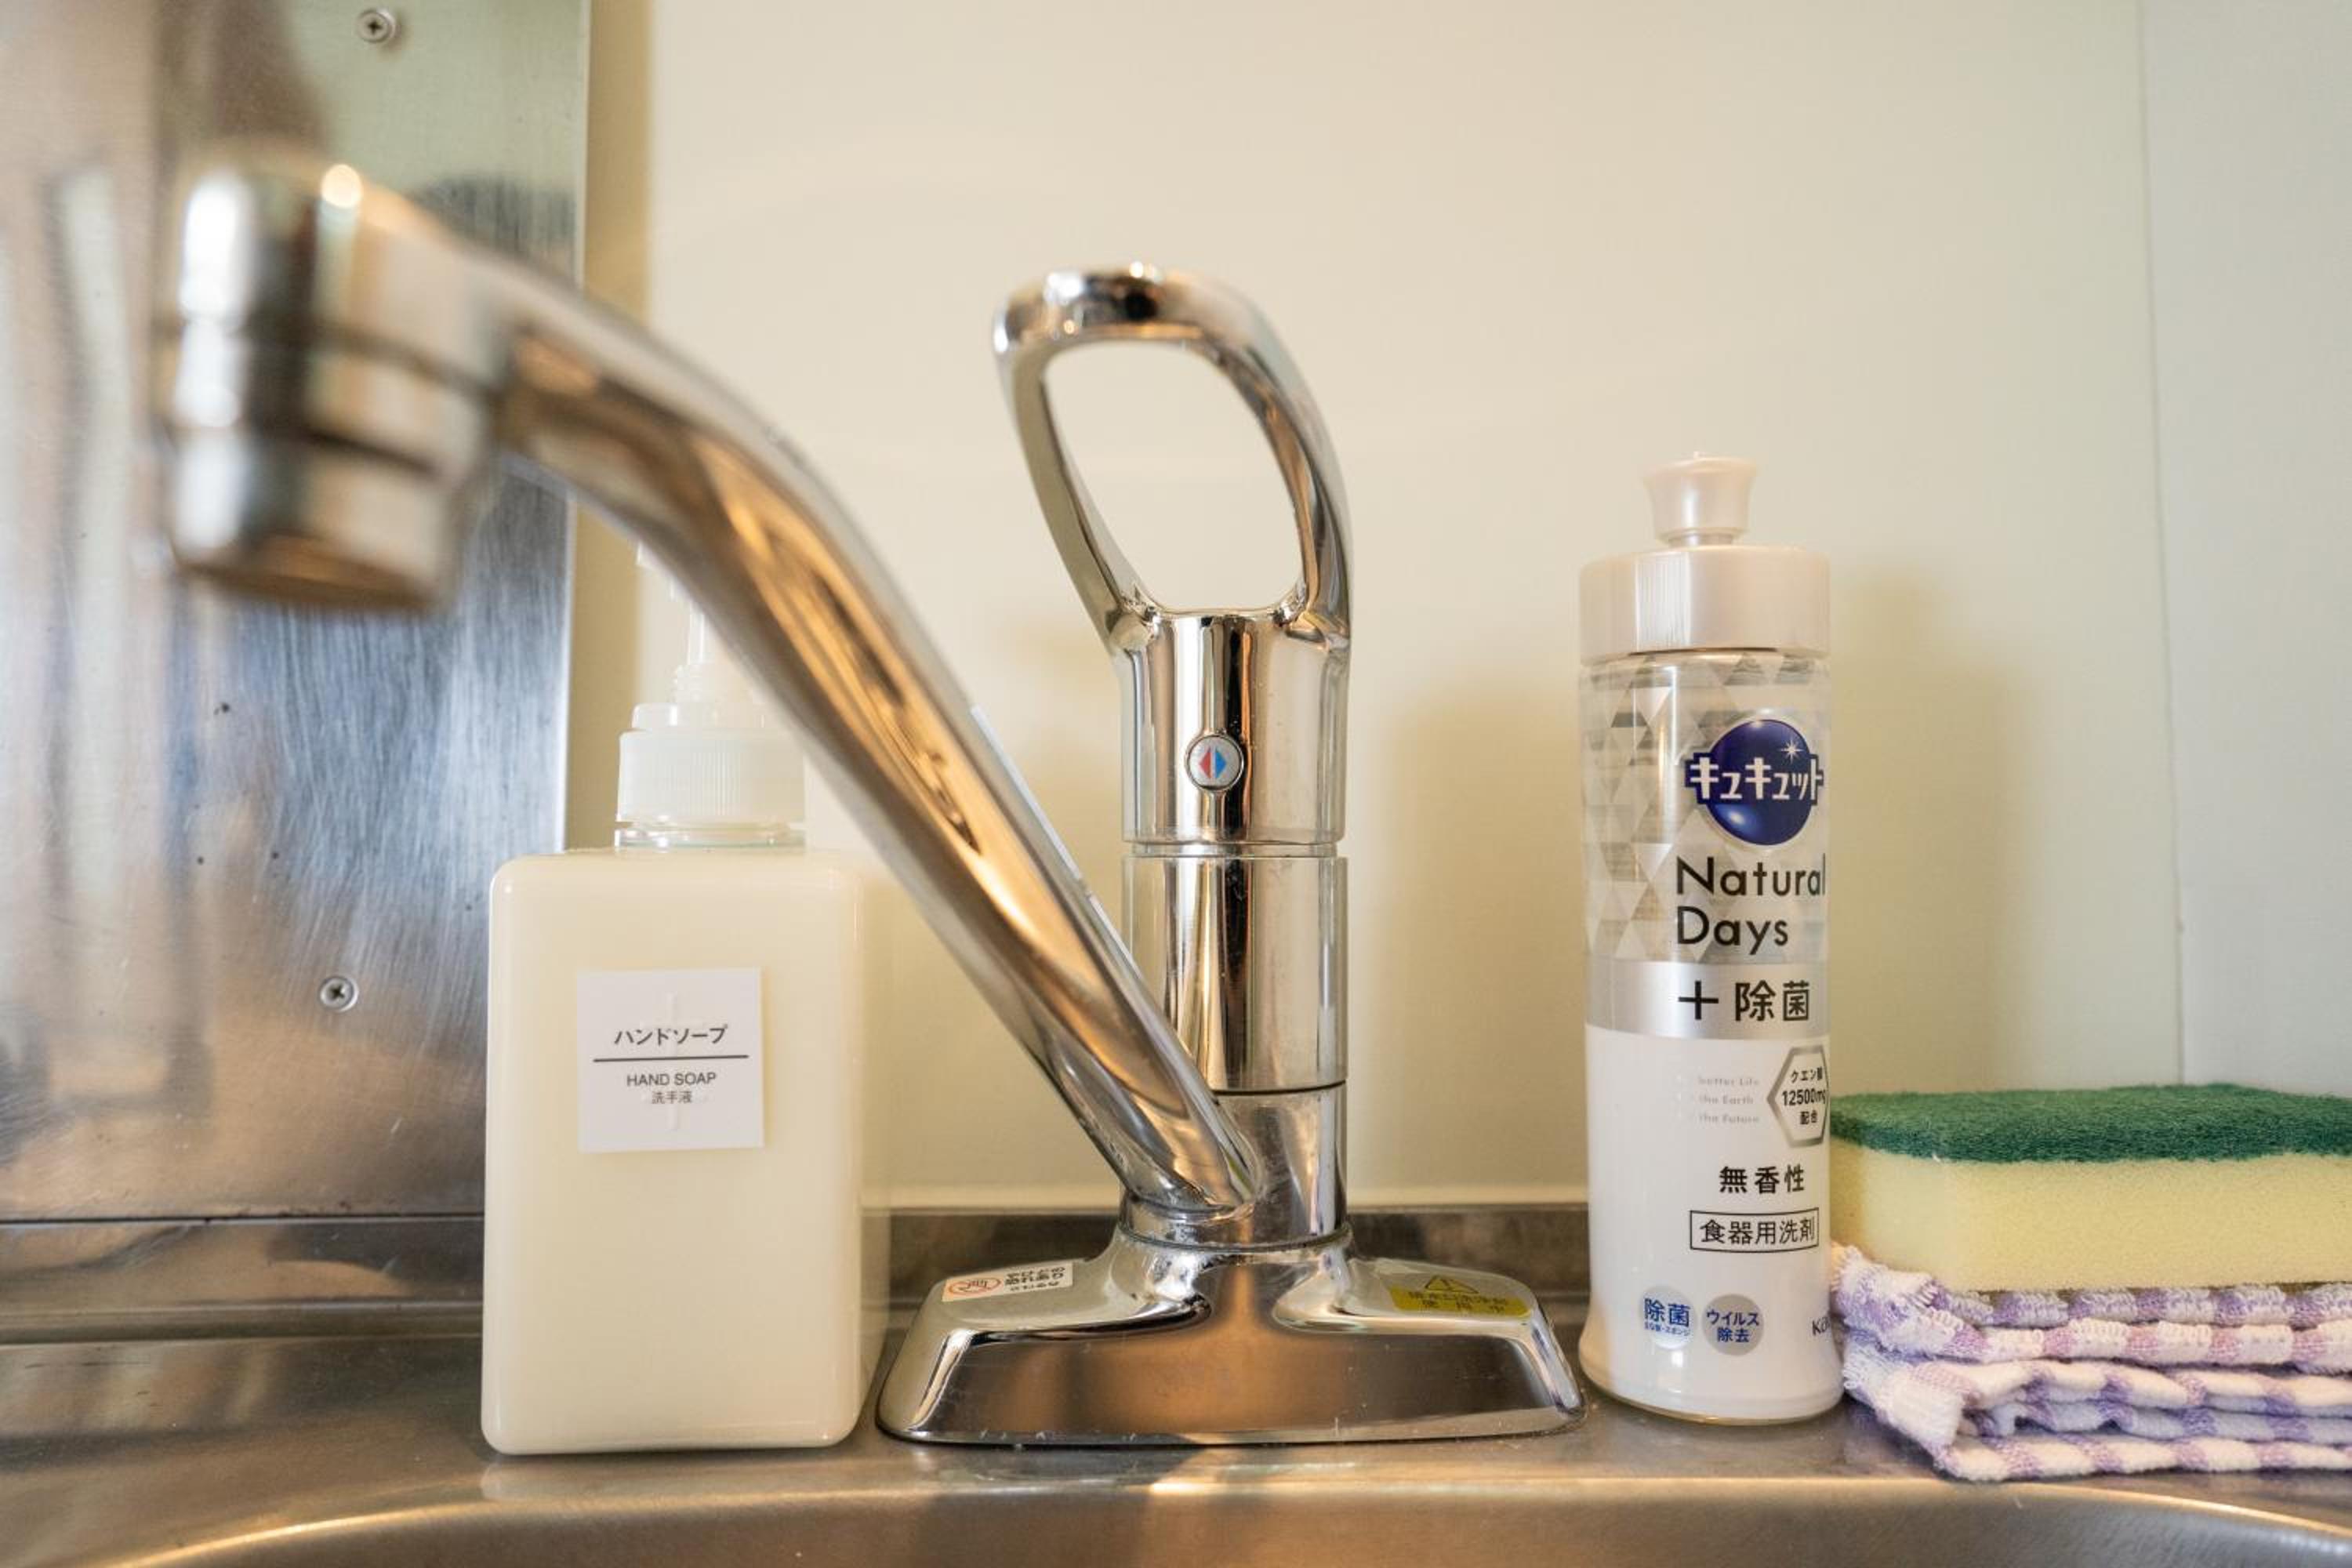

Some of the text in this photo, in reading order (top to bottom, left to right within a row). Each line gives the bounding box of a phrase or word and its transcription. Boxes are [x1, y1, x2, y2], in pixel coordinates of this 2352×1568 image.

[1690, 757, 1823, 800] キュキュット
[1676, 852, 1826, 897] Natural
[1676, 906, 1788, 956] Days
[614, 1024, 728, 1046] ハンドソープ
[626, 1071, 717, 1087] HAND SOAP
[652, 1091, 693, 1104] 洗手液
[1719, 1163, 1806, 1194] 無香性
[1699, 1216, 1816, 1245] 食器用洗剤
[1643, 1298, 1691, 1327] 除菌
[1706, 1309, 1760, 1327] ウイルス
[1717, 1327, 1750, 1343] 除去
